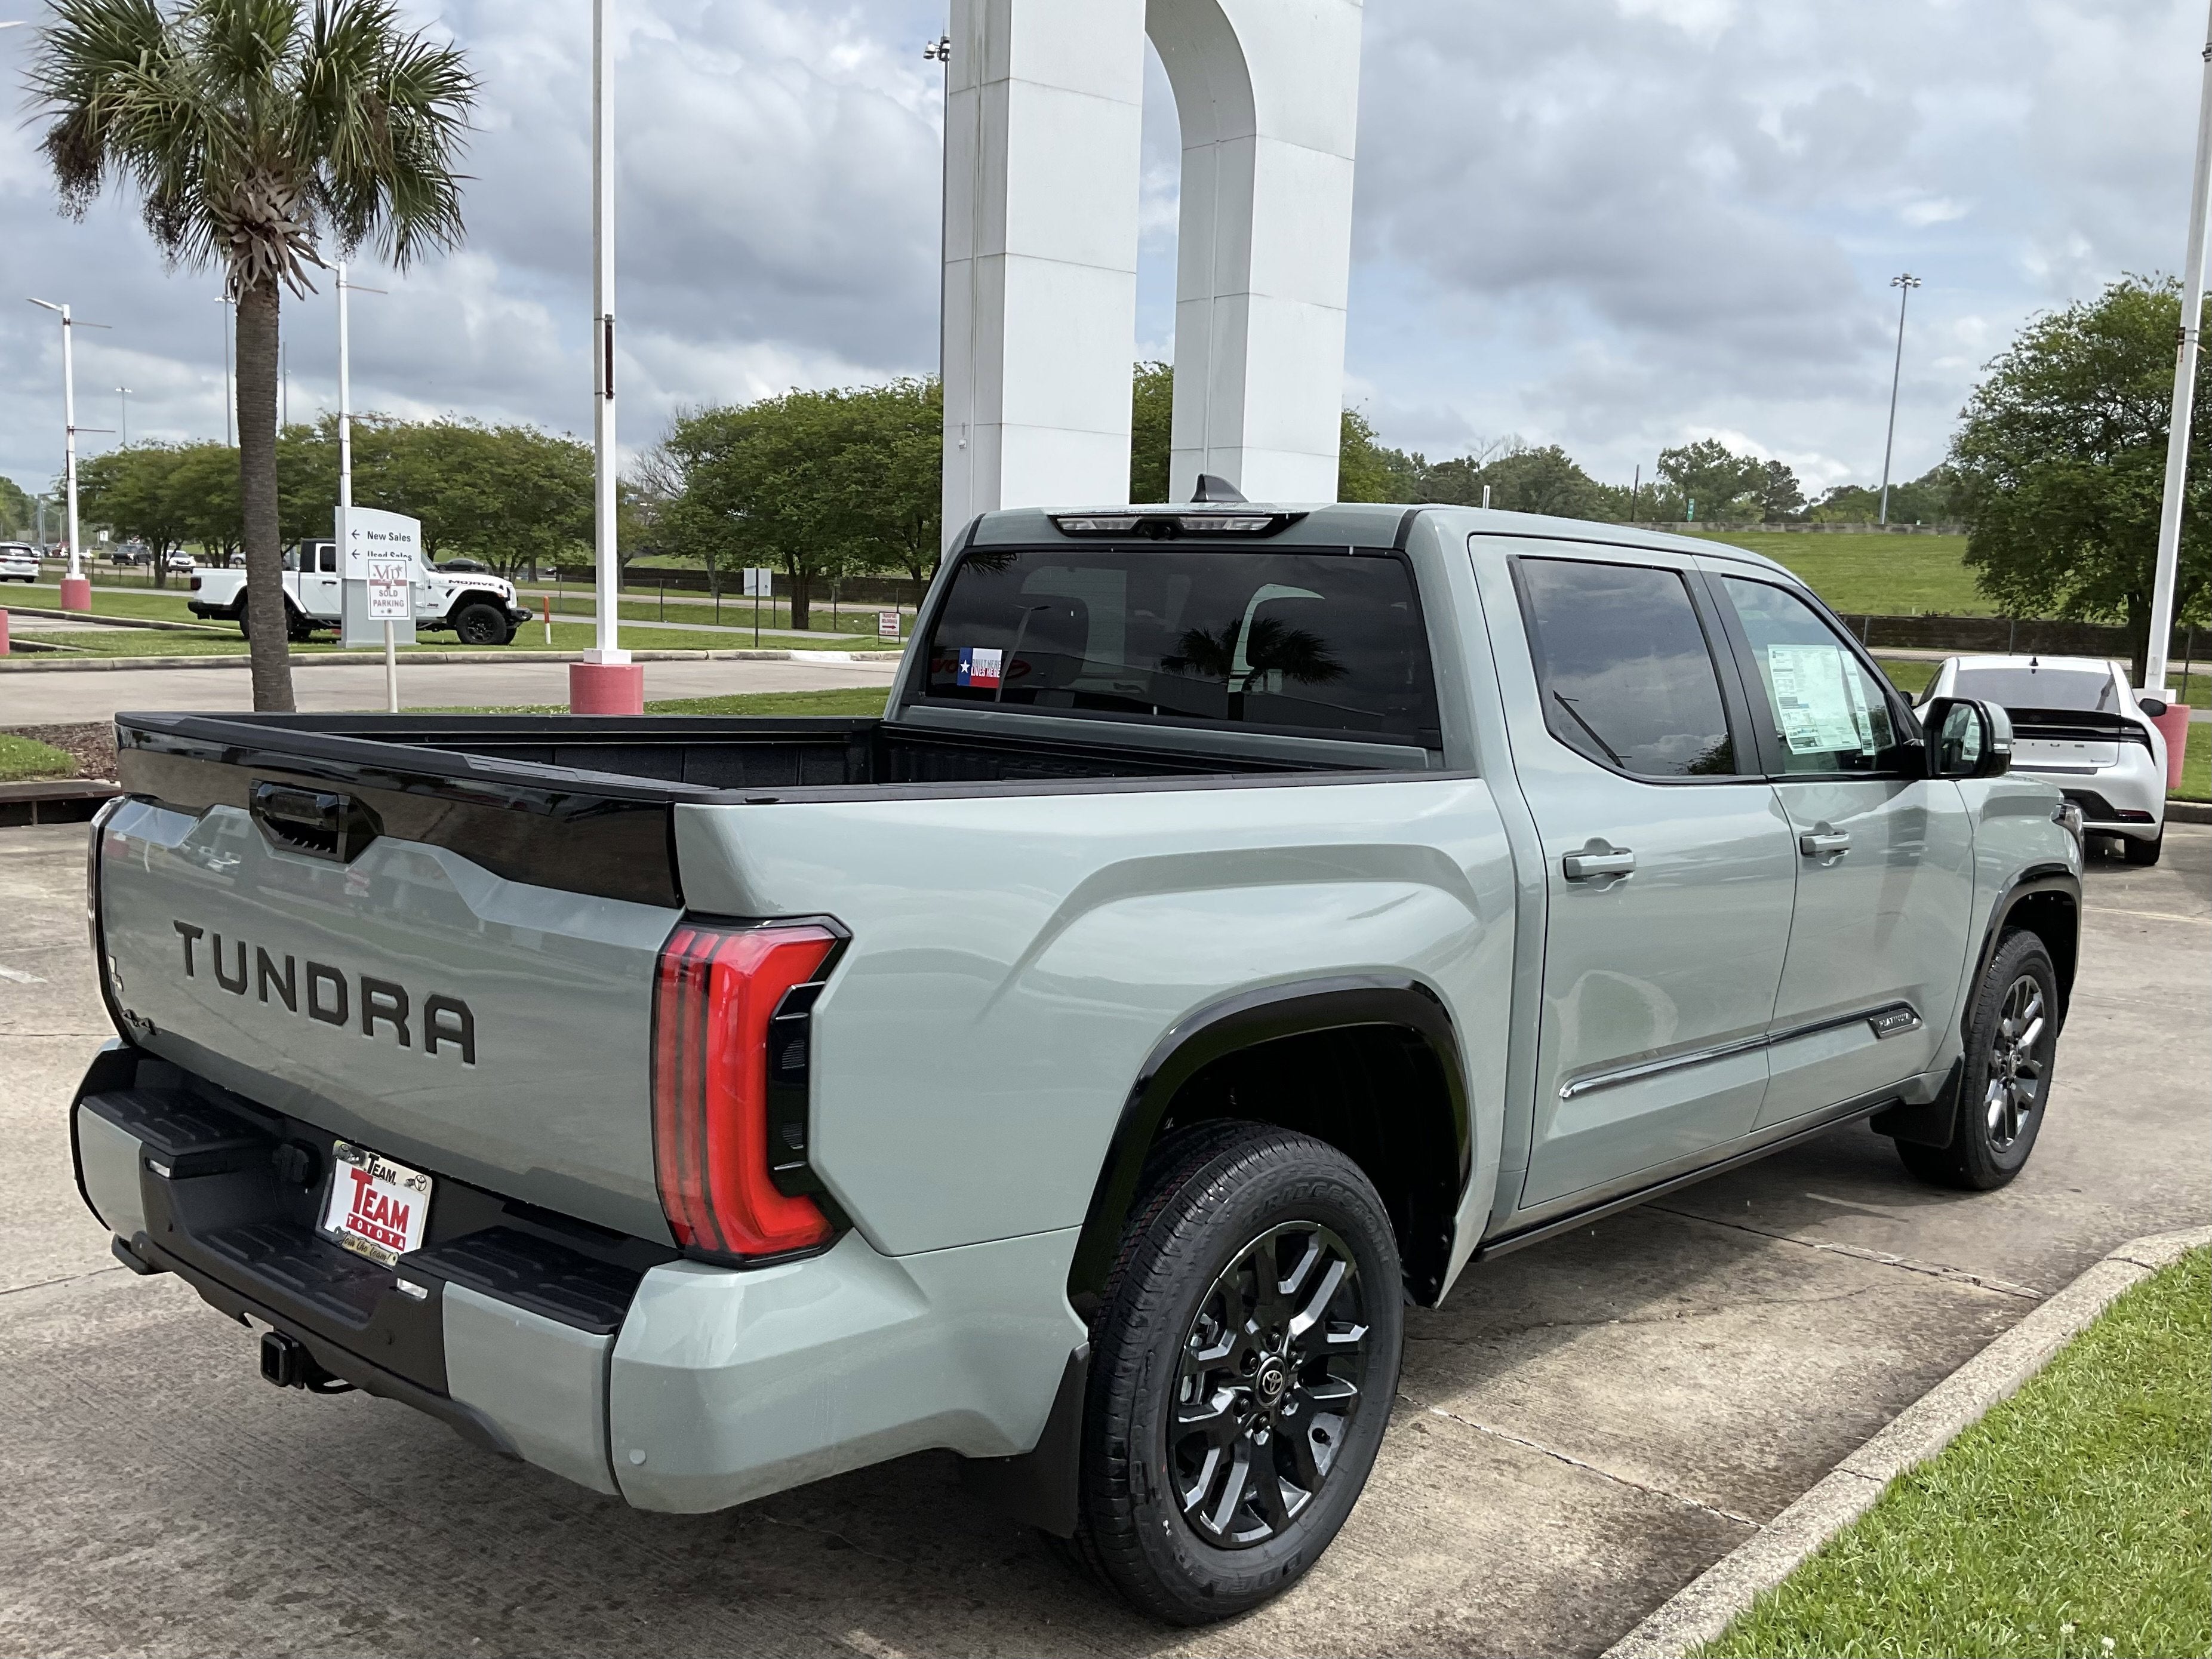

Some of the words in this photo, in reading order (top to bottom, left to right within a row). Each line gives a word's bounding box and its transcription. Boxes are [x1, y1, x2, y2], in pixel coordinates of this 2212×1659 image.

[367, 531, 386, 540] New
[389, 532, 411, 542] Sales
[971, 667, 986, 677] LIVES
[986, 668, 1000, 678] HERE
[972, 658, 987, 669] BUILT
[987, 660, 1001, 669] HERE
[173, 919, 476, 1065] TUNDRA
[350, 1167, 410, 1234] TEAM
[348, 1217, 404, 1248] TOYOTA
